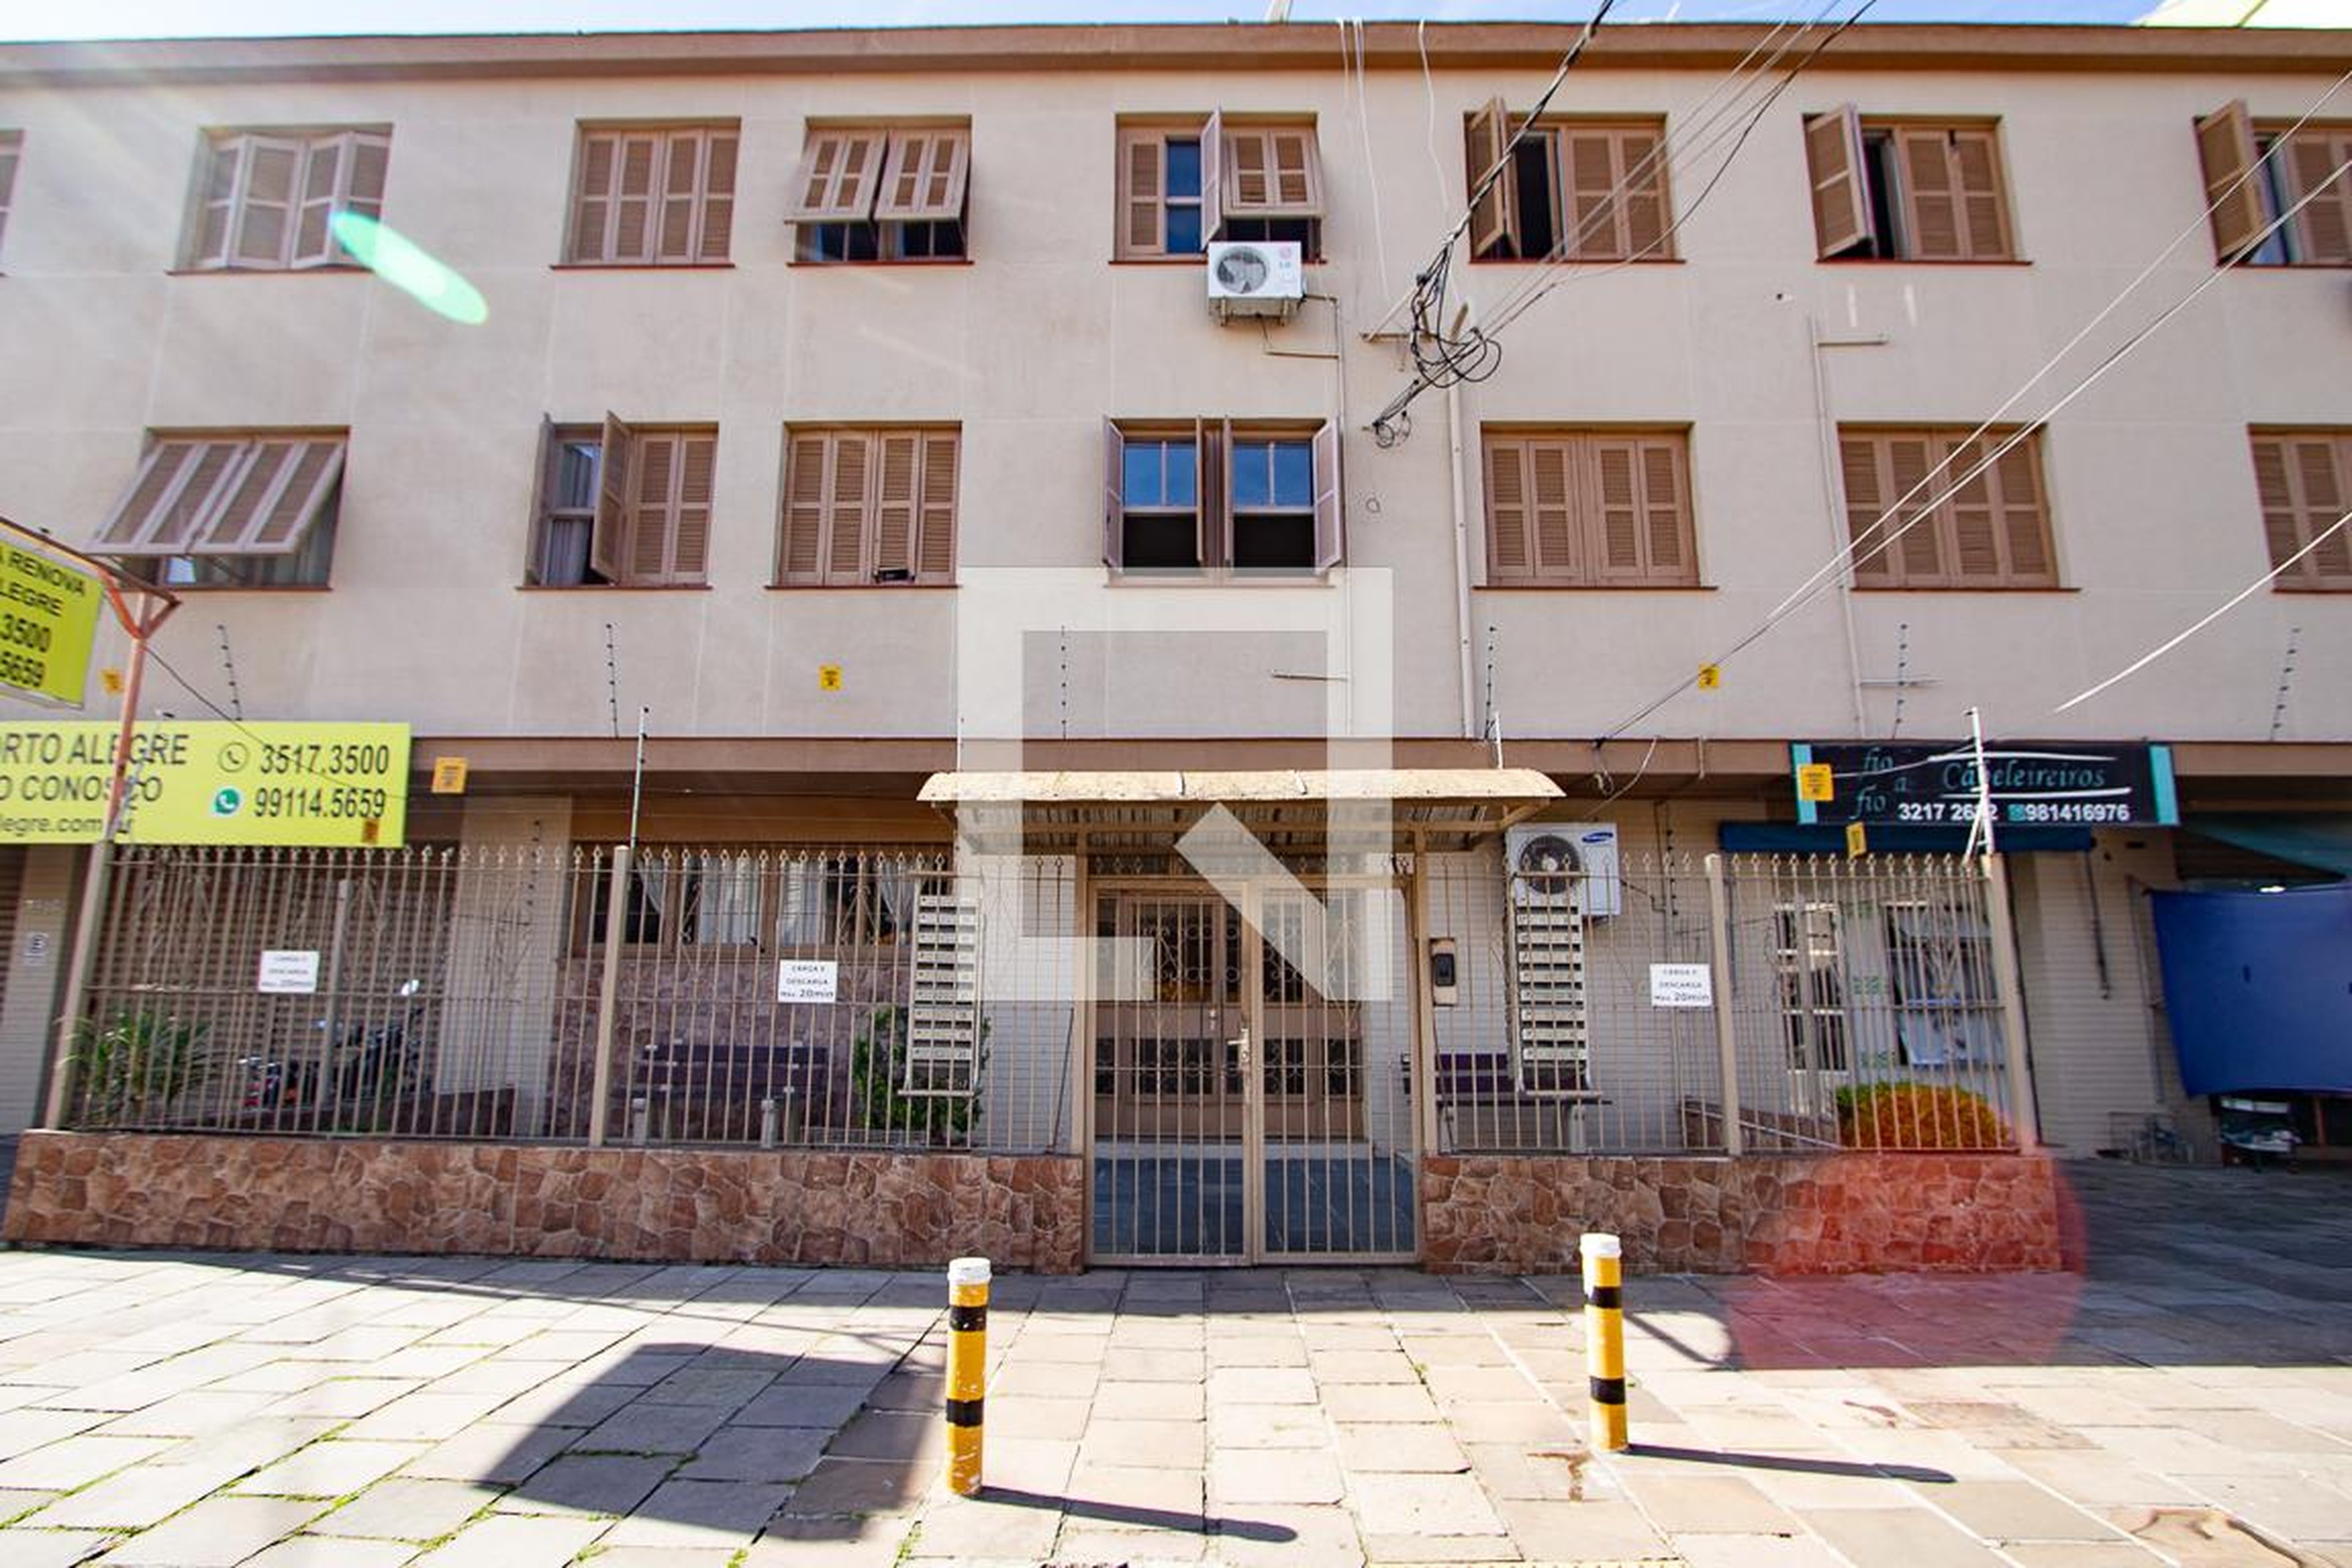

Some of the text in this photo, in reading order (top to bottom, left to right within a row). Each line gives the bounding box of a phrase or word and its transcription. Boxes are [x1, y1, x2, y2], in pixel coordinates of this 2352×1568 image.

[260, 745, 389, 774] 3517.3500
[1943, 758, 2106, 790] Caeleireiros
[255, 788, 386, 818] 99114.5659
[1849, 785, 1887, 820] fio
[1899, 802, 2130, 821] 3217 262 981416976
